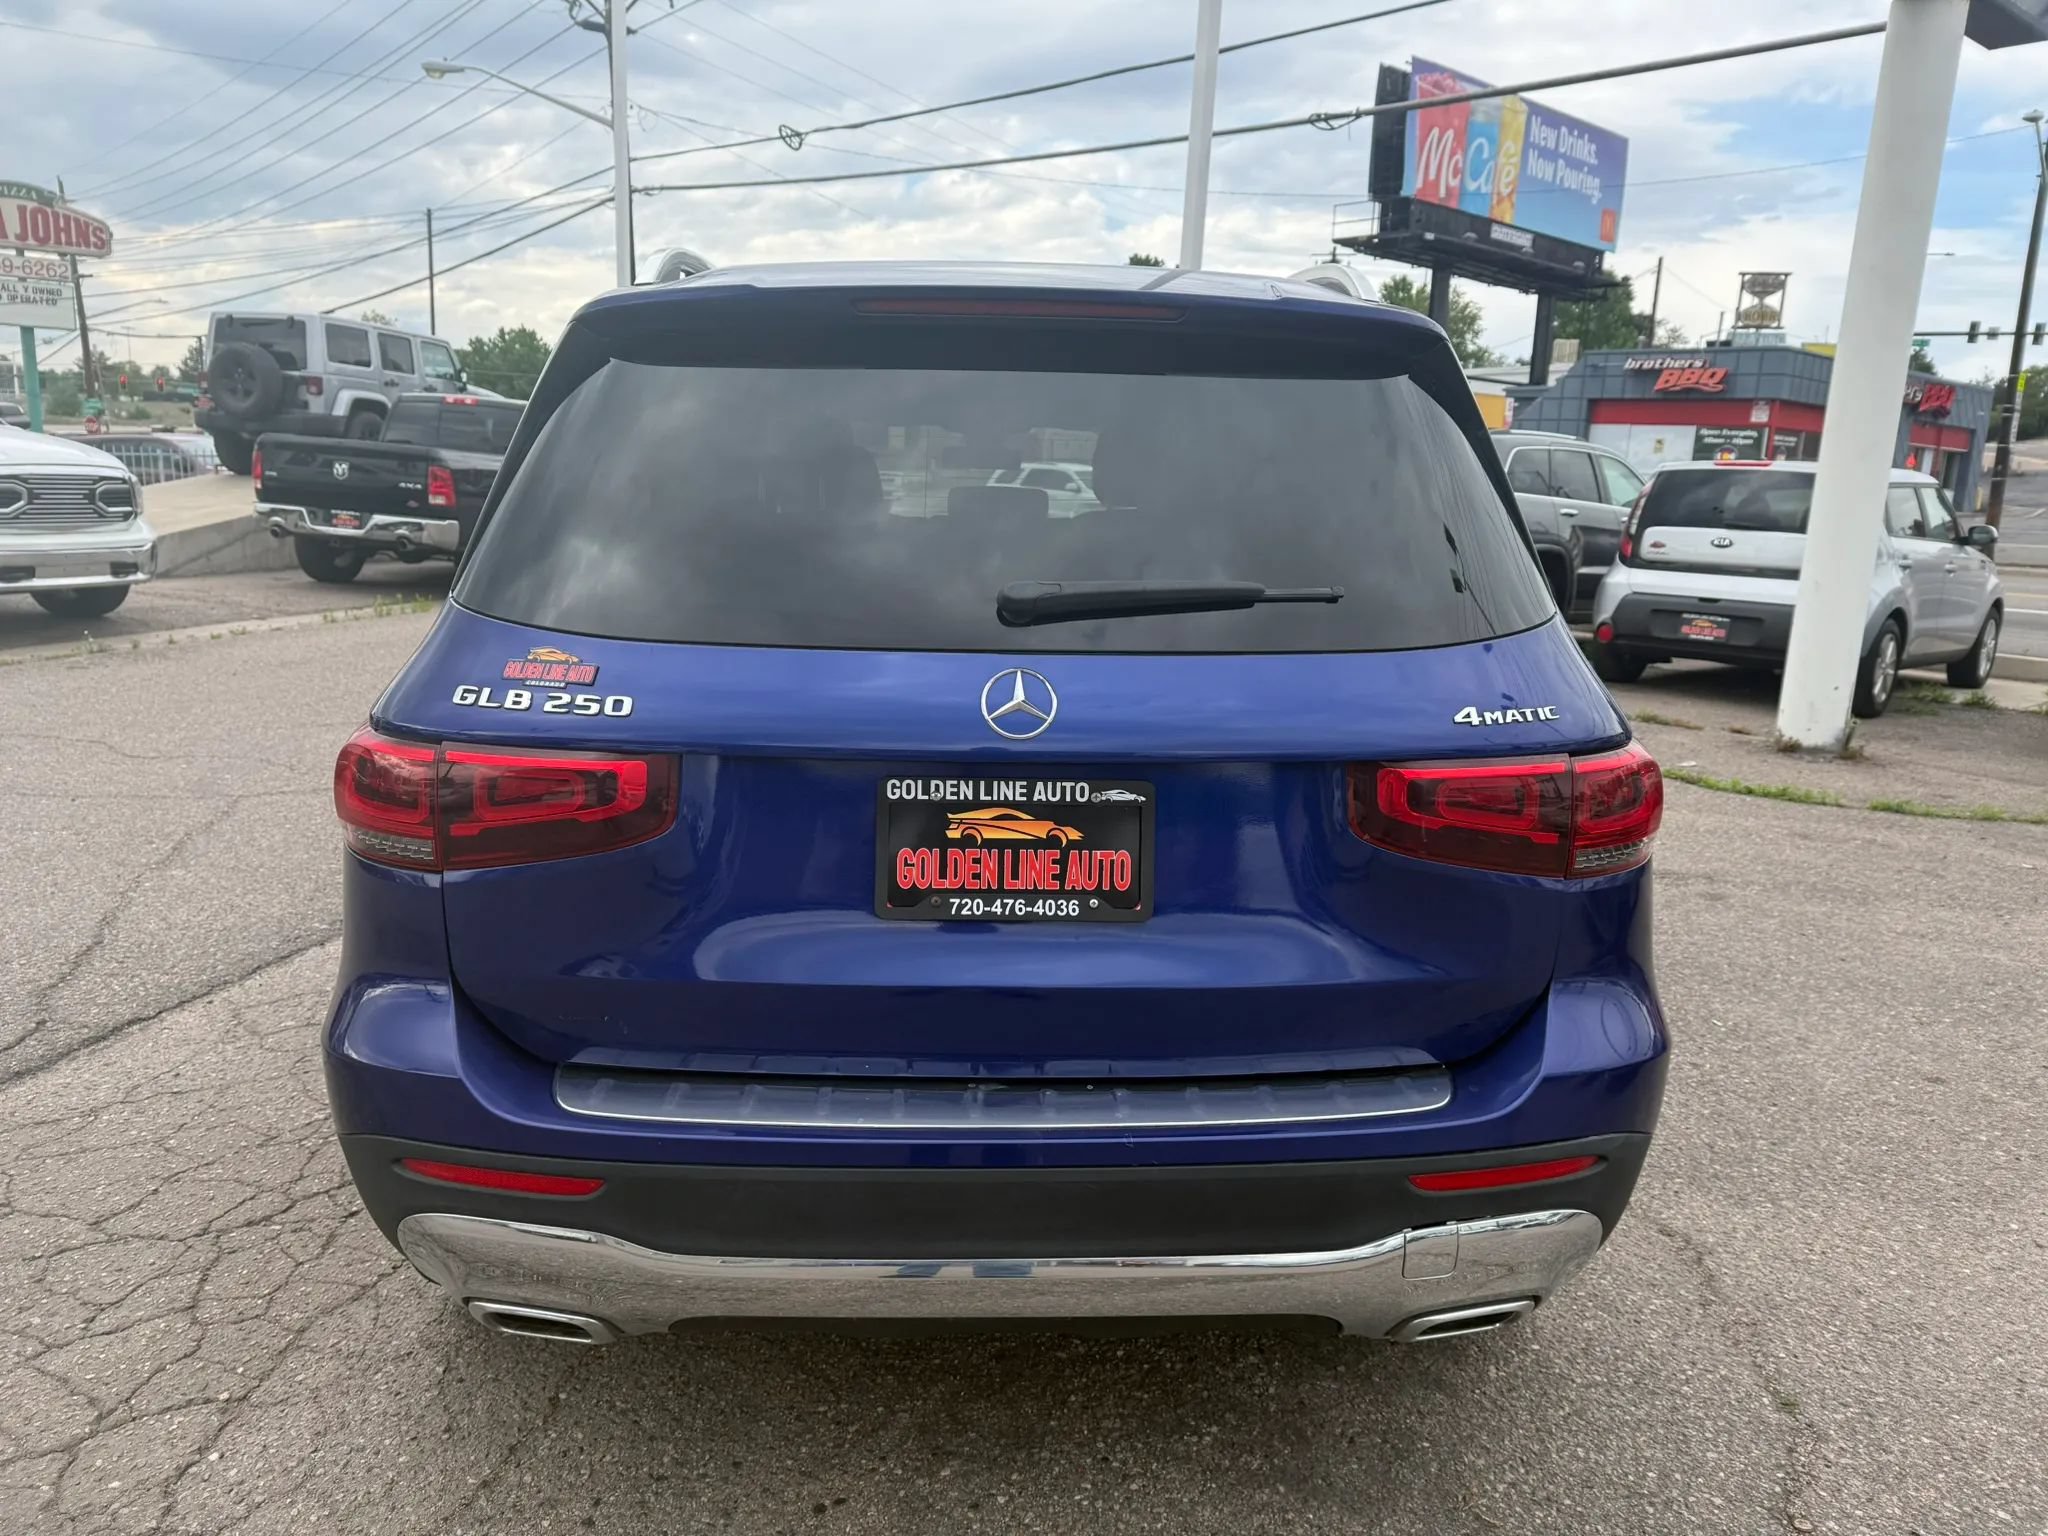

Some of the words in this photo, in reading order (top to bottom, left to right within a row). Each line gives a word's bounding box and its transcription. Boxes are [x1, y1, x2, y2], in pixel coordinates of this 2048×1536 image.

[1529, 114, 1558, 150] New
[1559, 125, 1598, 165] Drinks.
[1527, 148, 1556, 182] Now
[1555, 158, 1602, 205] Pouring.
[0, 185, 36, 200] IZZA
[31, 286, 62, 297] OWNED
[1624, 357, 1704, 370] brothers
[1653, 368, 1728, 393] BBQ
[503, 661, 545, 679] GOLDEN
[542, 663, 569, 681] LINE
[565, 665, 595, 683] AUTO
[452, 684, 533, 711] GLB
[543, 692, 633, 717] 250
[1453, 705, 1560, 726] 4MATIC
[886, 779, 973, 801] GOLDEN
[979, 780, 1028, 802] LINE
[1033, 782, 1090, 803] AUTO
[896, 847, 998, 890] GOLDEN
[1003, 848, 1061, 891] LINE
[1065, 850, 1132, 891] AUTO
[949, 898, 1080, 917] 720-476-4036
